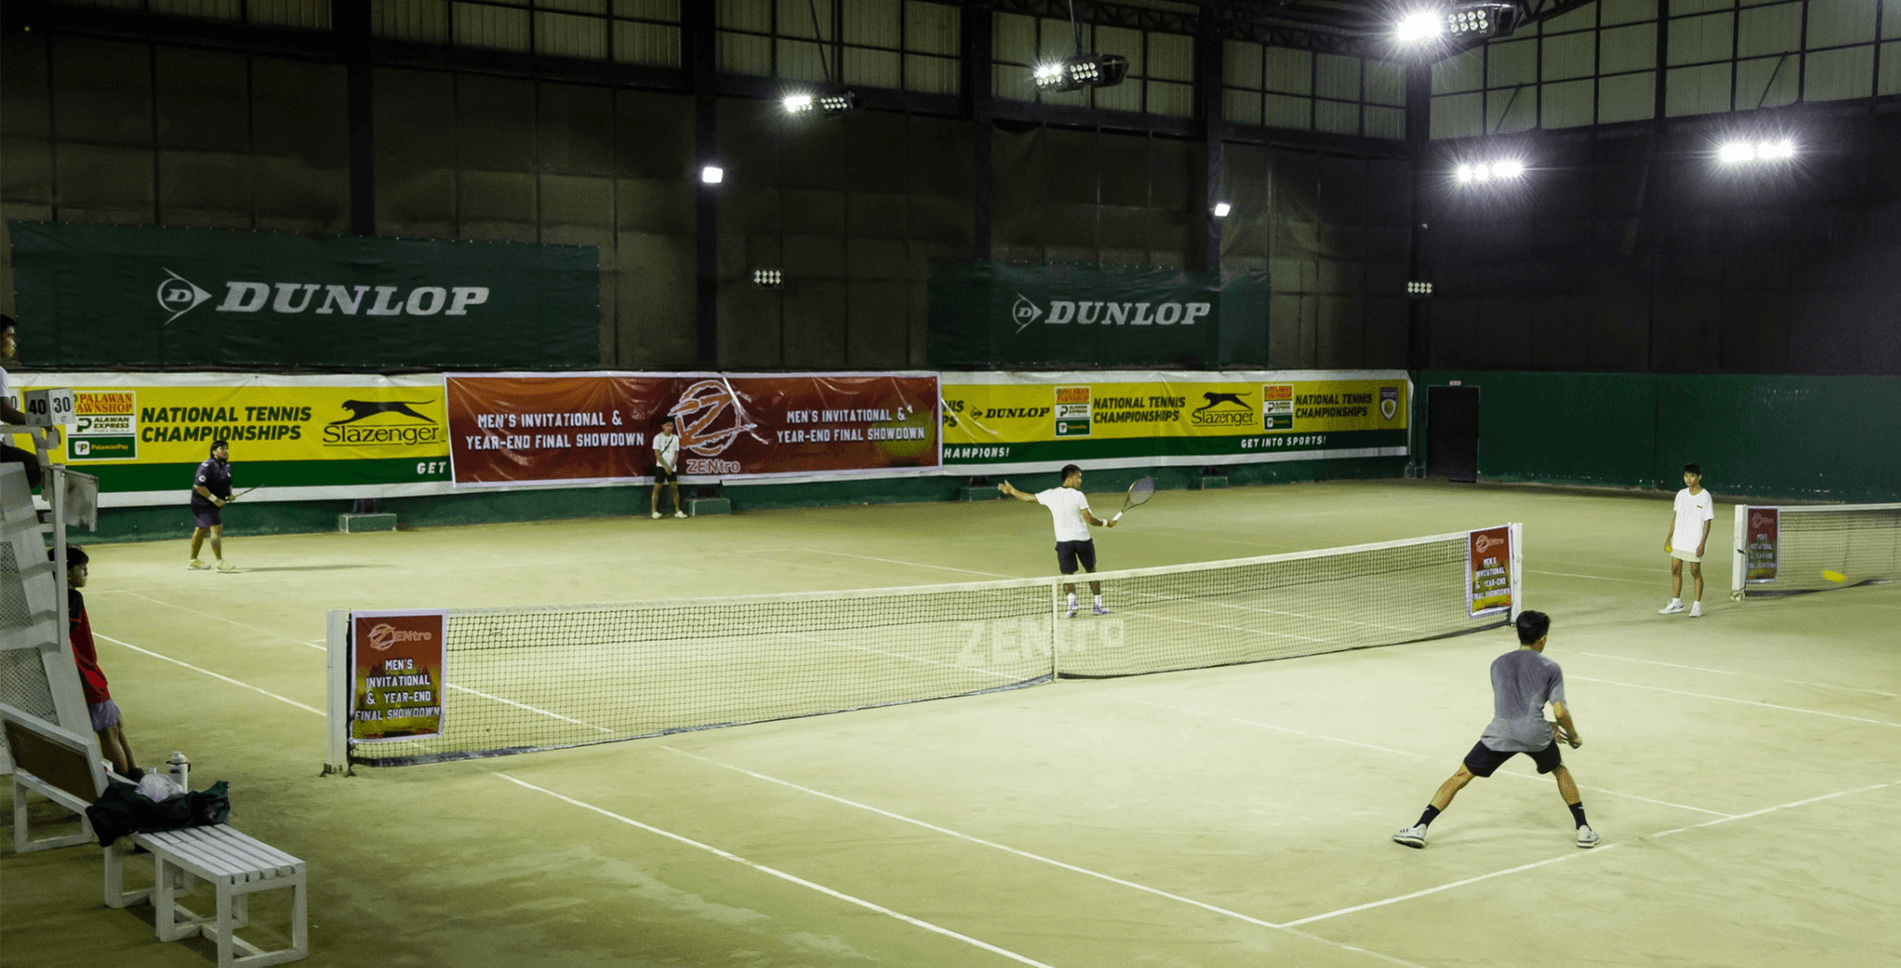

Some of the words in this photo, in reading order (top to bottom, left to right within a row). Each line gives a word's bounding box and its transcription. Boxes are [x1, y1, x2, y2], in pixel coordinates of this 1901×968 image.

[216, 281, 490, 316] DUNLOP
[1044, 300, 1211, 325] DUNLOP
[53, 397, 71, 413] 30
[80, 394, 132, 404] PALAWAN
[1093, 397, 1146, 409] NATIONAL
[1148, 396, 1186, 408] TENNIS
[1295, 394, 1340, 405] NATIONAL
[1342, 393, 1373, 404] TENNIS
[29, 399, 47, 415] 40
[74, 403, 132, 413] AWNSHOP
[141, 407, 239, 423] NATIONAL
[245, 406, 312, 422] TENNIS
[985, 407, 1050, 419] DUNLOP
[1295, 406, 1368, 419] CHAMPIONSHIPS
[477, 414, 517, 428] MEN'S
[521, 412, 606, 427] INVITATIONAL
[611, 410, 623, 426] &
[786, 409, 818, 423] MEN'S
[822, 408, 892, 422] INVITATIONAL
[897, 407, 906, 420] &
[1093, 410, 1180, 423] CHAMPIONSHIPS
[1191, 410, 1254, 427] Slazenger
[141, 425, 302, 442] CHAMPIONSHIPS
[322, 425, 440, 445] Slazenger
[777, 430, 830, 444] YEAR-END
[833, 429, 863, 442] FINAL
[867, 427, 925, 440] SHOWDOWN
[465, 436, 531, 450] YEAR-END
[535, 434, 571, 448] FINAL
[576, 433, 645, 447] SHOWDOWN
[1241, 438, 1259, 449] GET
[1261, 437, 1283, 448] INTO
[1286, 435, 1327, 447] SPORTS!
[416, 461, 447, 475] GET
[686, 458, 741, 474] ZENtro
[385, 659, 413, 670] MEN'S
[366, 674, 430, 688] INVITATIONAL
[366, 691, 376, 705] &
[384, 690, 431, 704] YEAR-END
[354, 710, 383, 721] FINAL
[387, 706, 440, 720] SHOWDOWN
